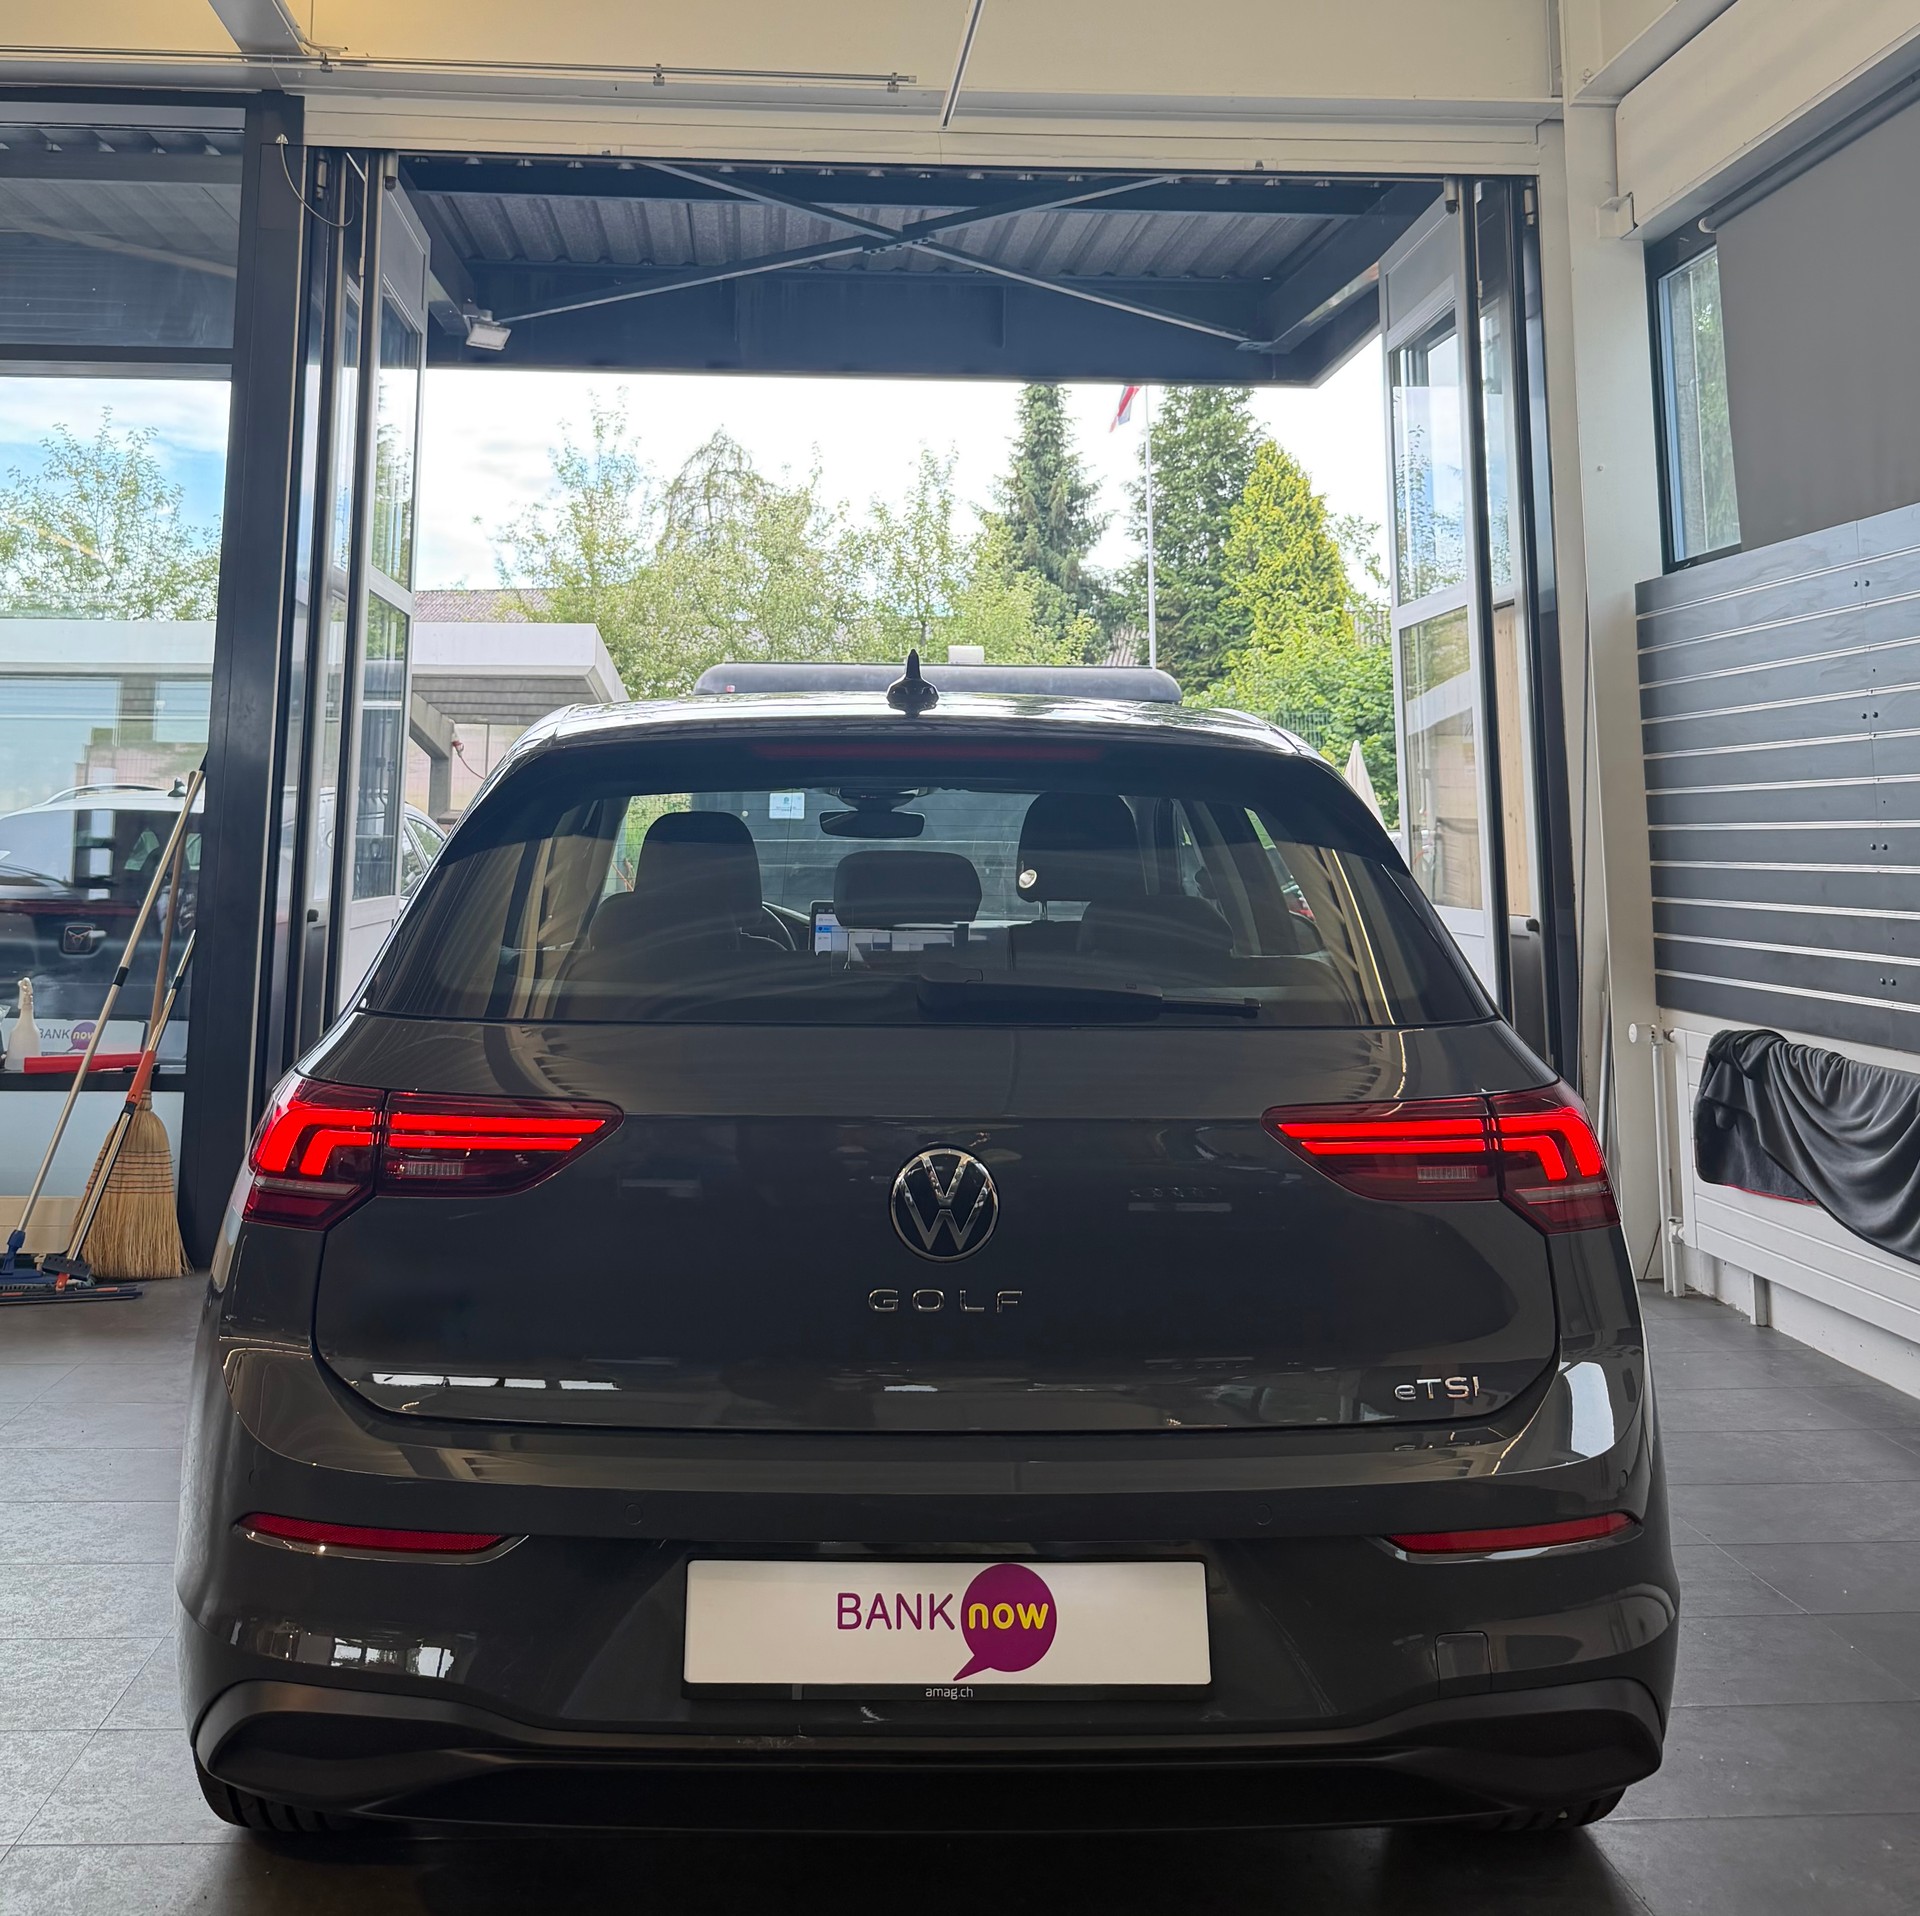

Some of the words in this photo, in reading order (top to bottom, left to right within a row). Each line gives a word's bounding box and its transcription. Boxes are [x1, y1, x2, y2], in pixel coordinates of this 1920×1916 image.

[867, 1288, 1023, 1313] GOLF
[1394, 1376, 1480, 1400] eTSI
[837, 1592, 955, 1630] BANK
[968, 1602, 1049, 1630] now
[925, 1686, 974, 1700] amag.ch
